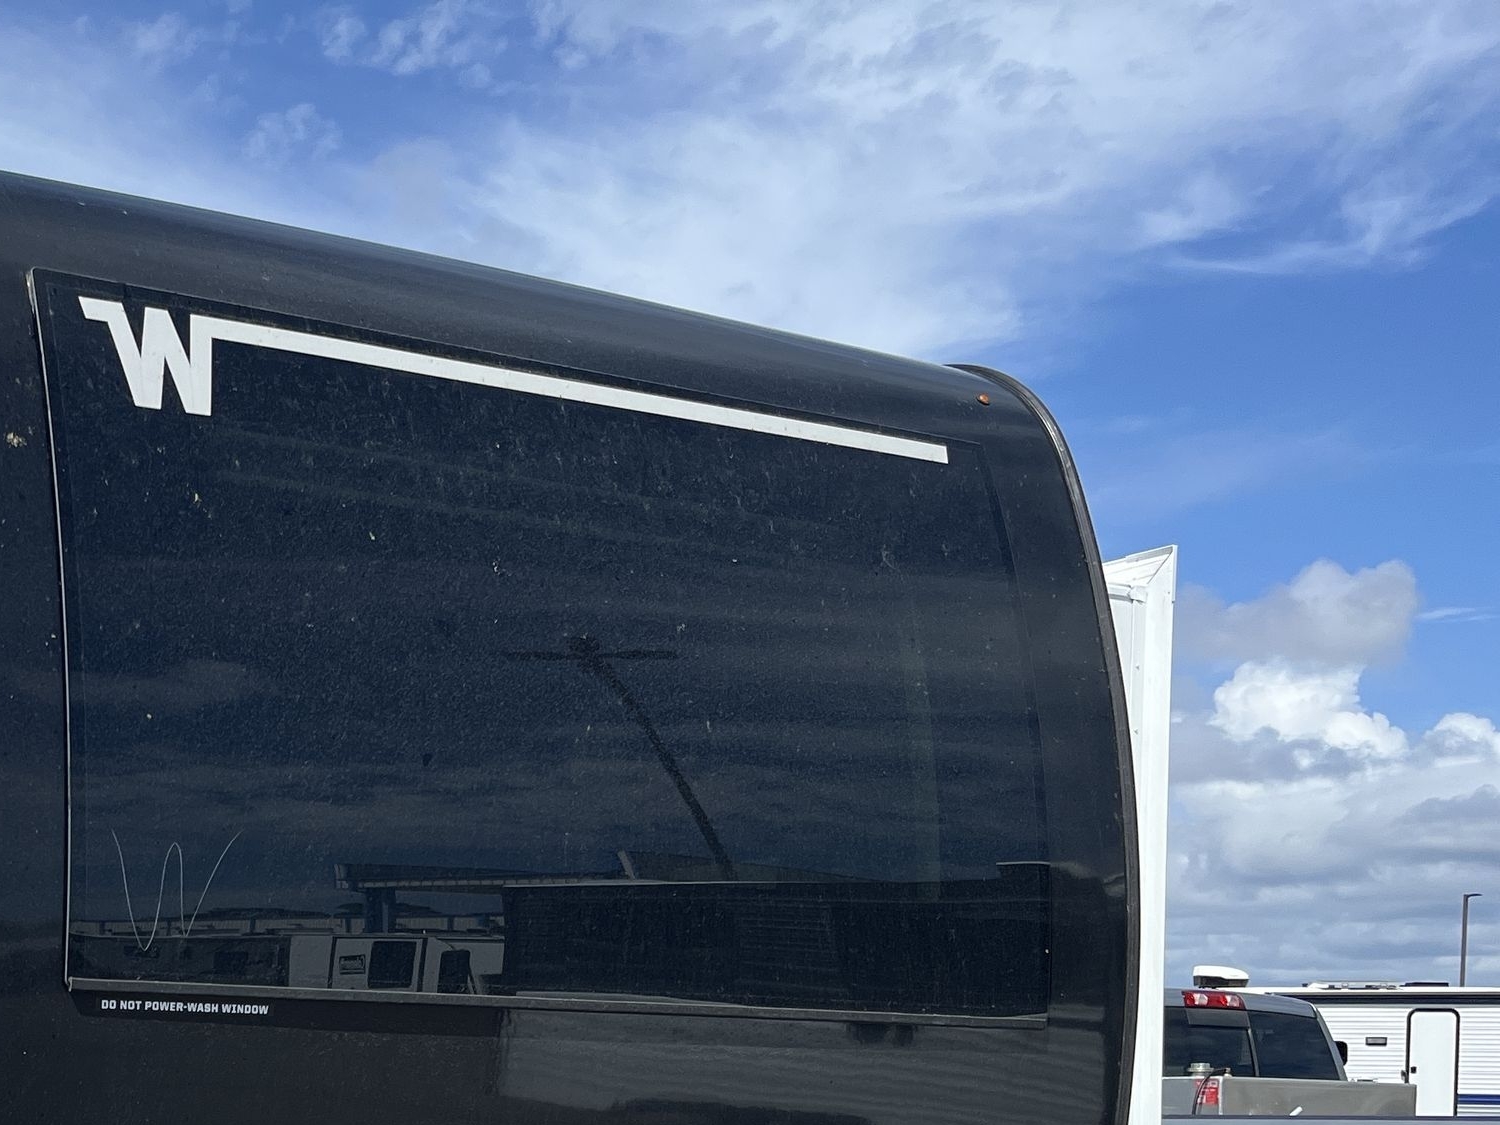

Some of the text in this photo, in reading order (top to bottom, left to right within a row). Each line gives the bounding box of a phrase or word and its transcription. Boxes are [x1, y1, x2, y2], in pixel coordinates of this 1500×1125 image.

[78, 296, 213, 416] W
[101, 1000, 269, 1015] DO NOT POWER-WASH WINDOW
